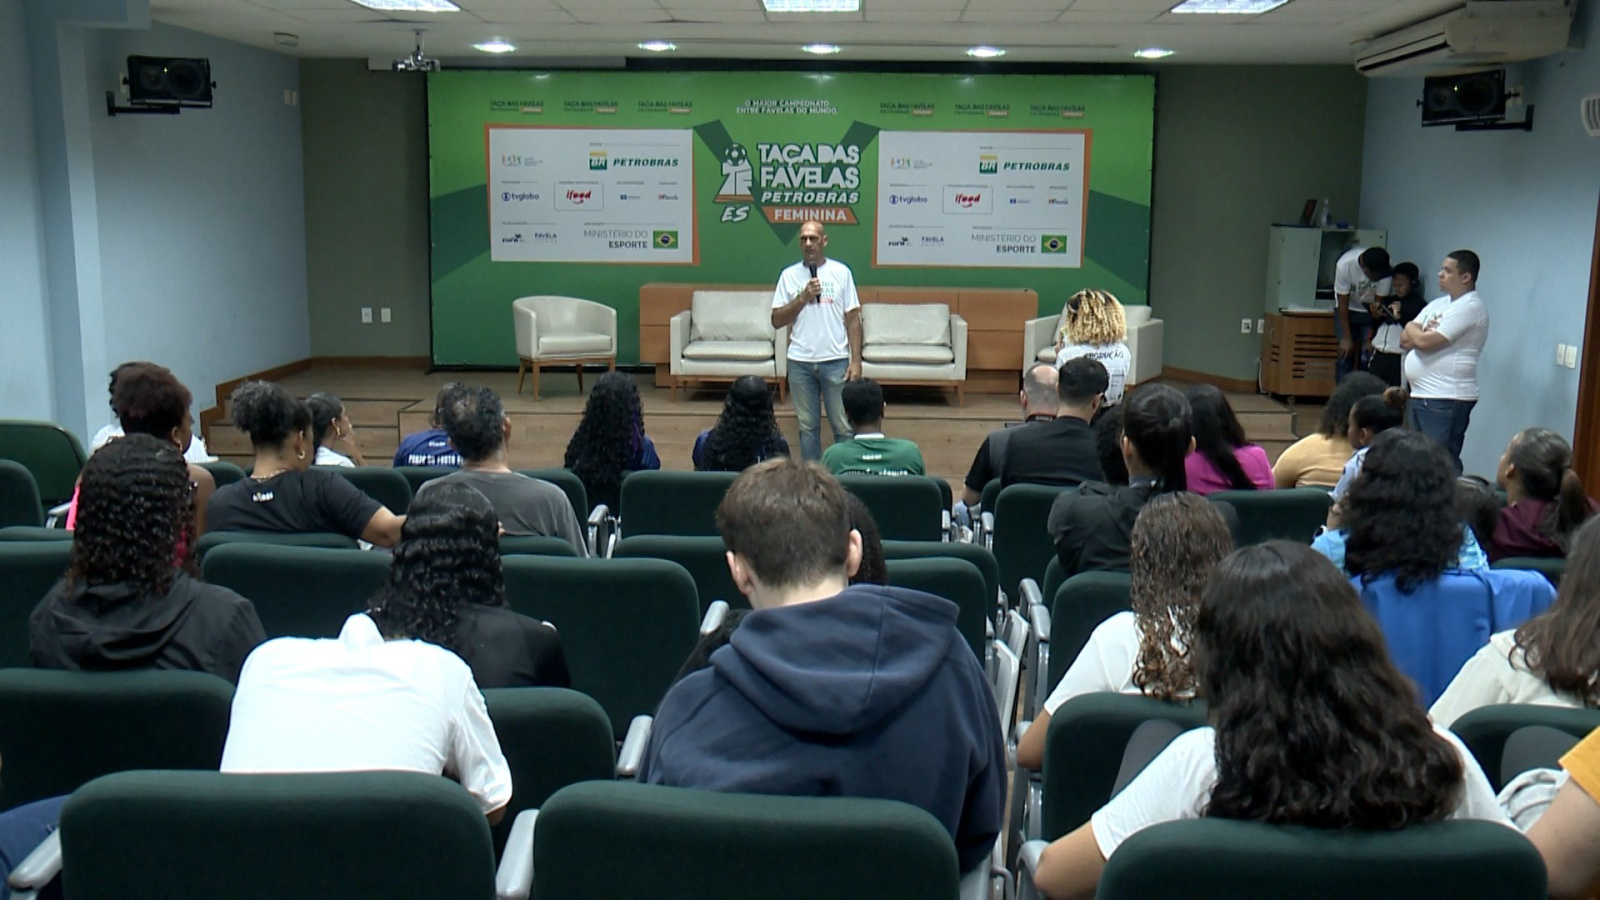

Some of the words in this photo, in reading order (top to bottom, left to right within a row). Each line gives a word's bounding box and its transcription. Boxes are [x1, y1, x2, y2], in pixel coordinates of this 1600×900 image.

[758, 144, 816, 167] TAÇA
[817, 145, 860, 165] DAS
[613, 158, 679, 167] PETROBRAS
[1003, 162, 1070, 171] PETROBRAS
[760, 166, 860, 188] FAVELAS
[566, 189, 592, 200] ifood
[761, 191, 859, 204] PETROBRAS
[955, 193, 981, 203] ifood
[721, 206, 749, 222] ES
[774, 208, 847, 221] FEMININA
[583, 229, 632, 238] MINISTÉRIO
[634, 230, 648, 238] DO
[971, 233, 1020, 242] MINISTÉRIO
[1022, 235, 1036, 243] DO
[609, 241, 648, 249] ESPORTE
[996, 245, 1036, 253] ESPORTE
